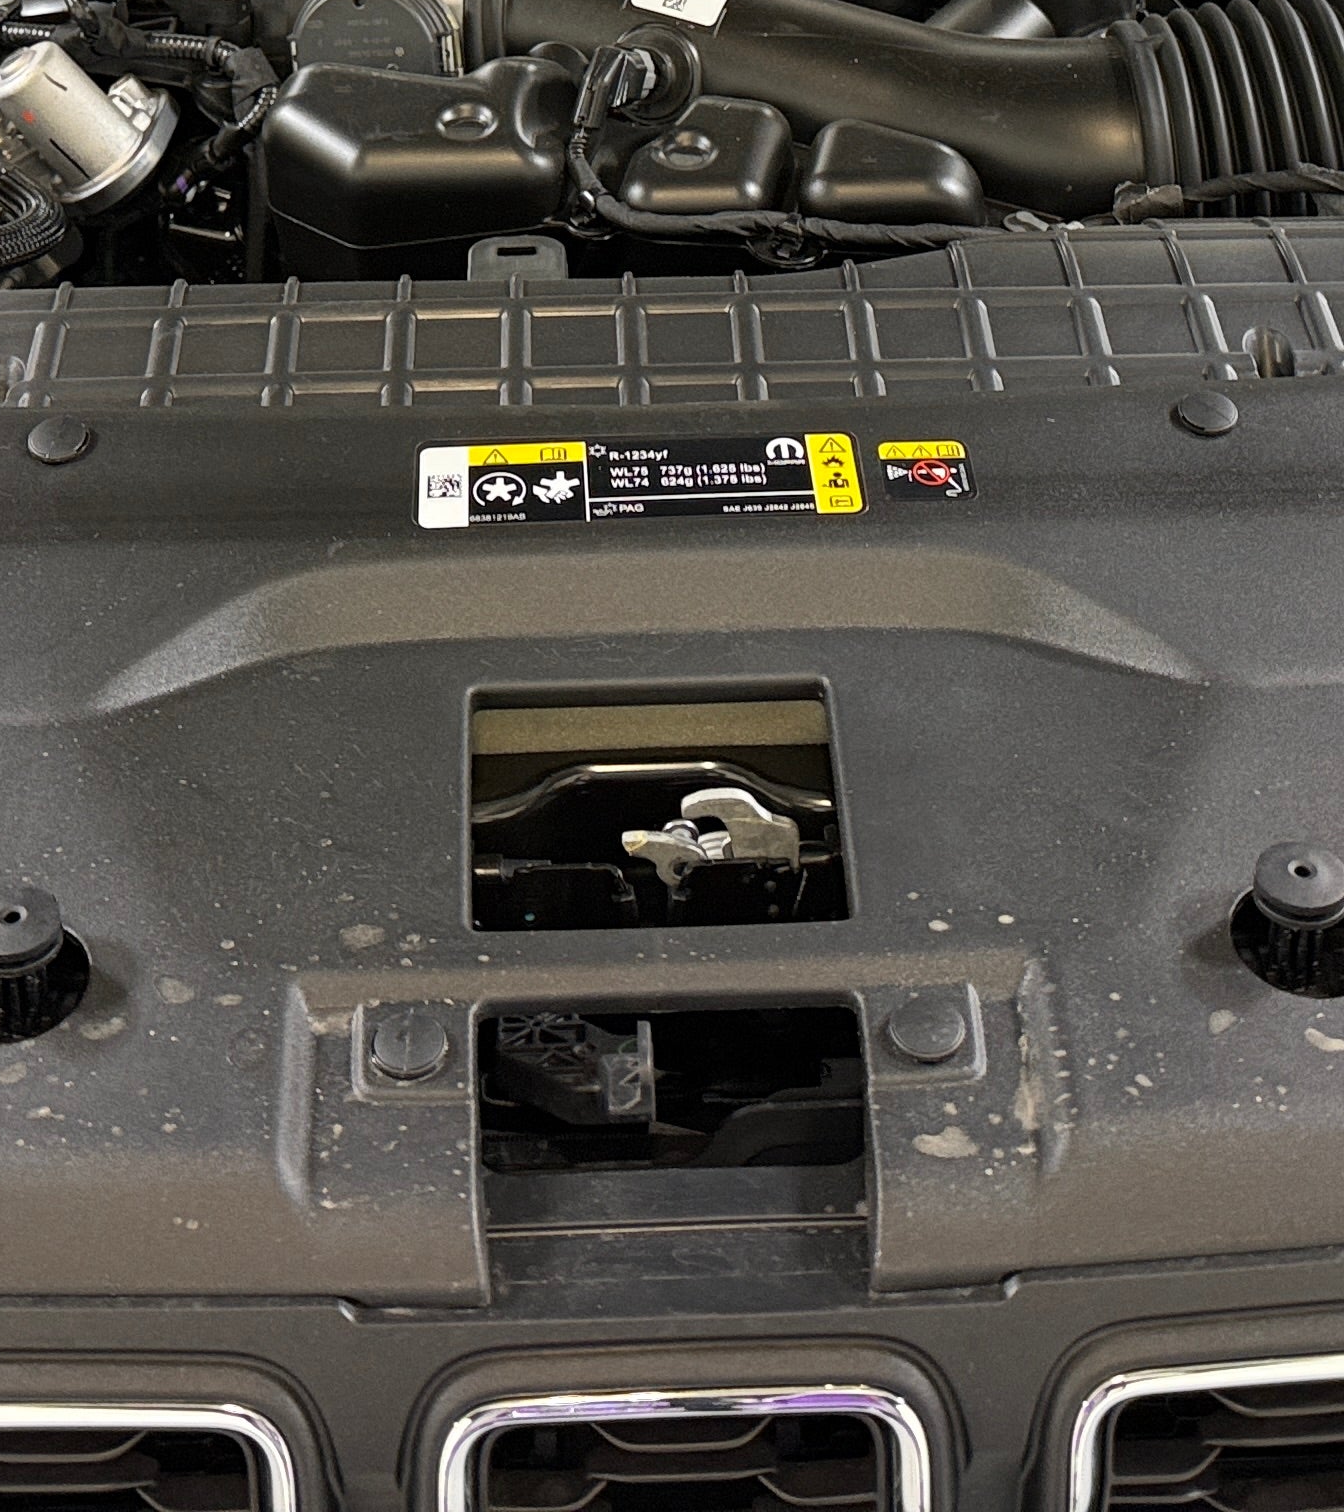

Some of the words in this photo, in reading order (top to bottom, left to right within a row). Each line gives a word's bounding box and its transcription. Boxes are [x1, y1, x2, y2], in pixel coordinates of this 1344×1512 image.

[609, 449, 668, 461] R-1234yf
[660, 465, 692, 476] 737g
[739, 462, 766, 473] lbs)
[660, 476, 693, 487] 624g
[741, 474, 767, 485] lbs)
[618, 503, 644, 513] PAG
